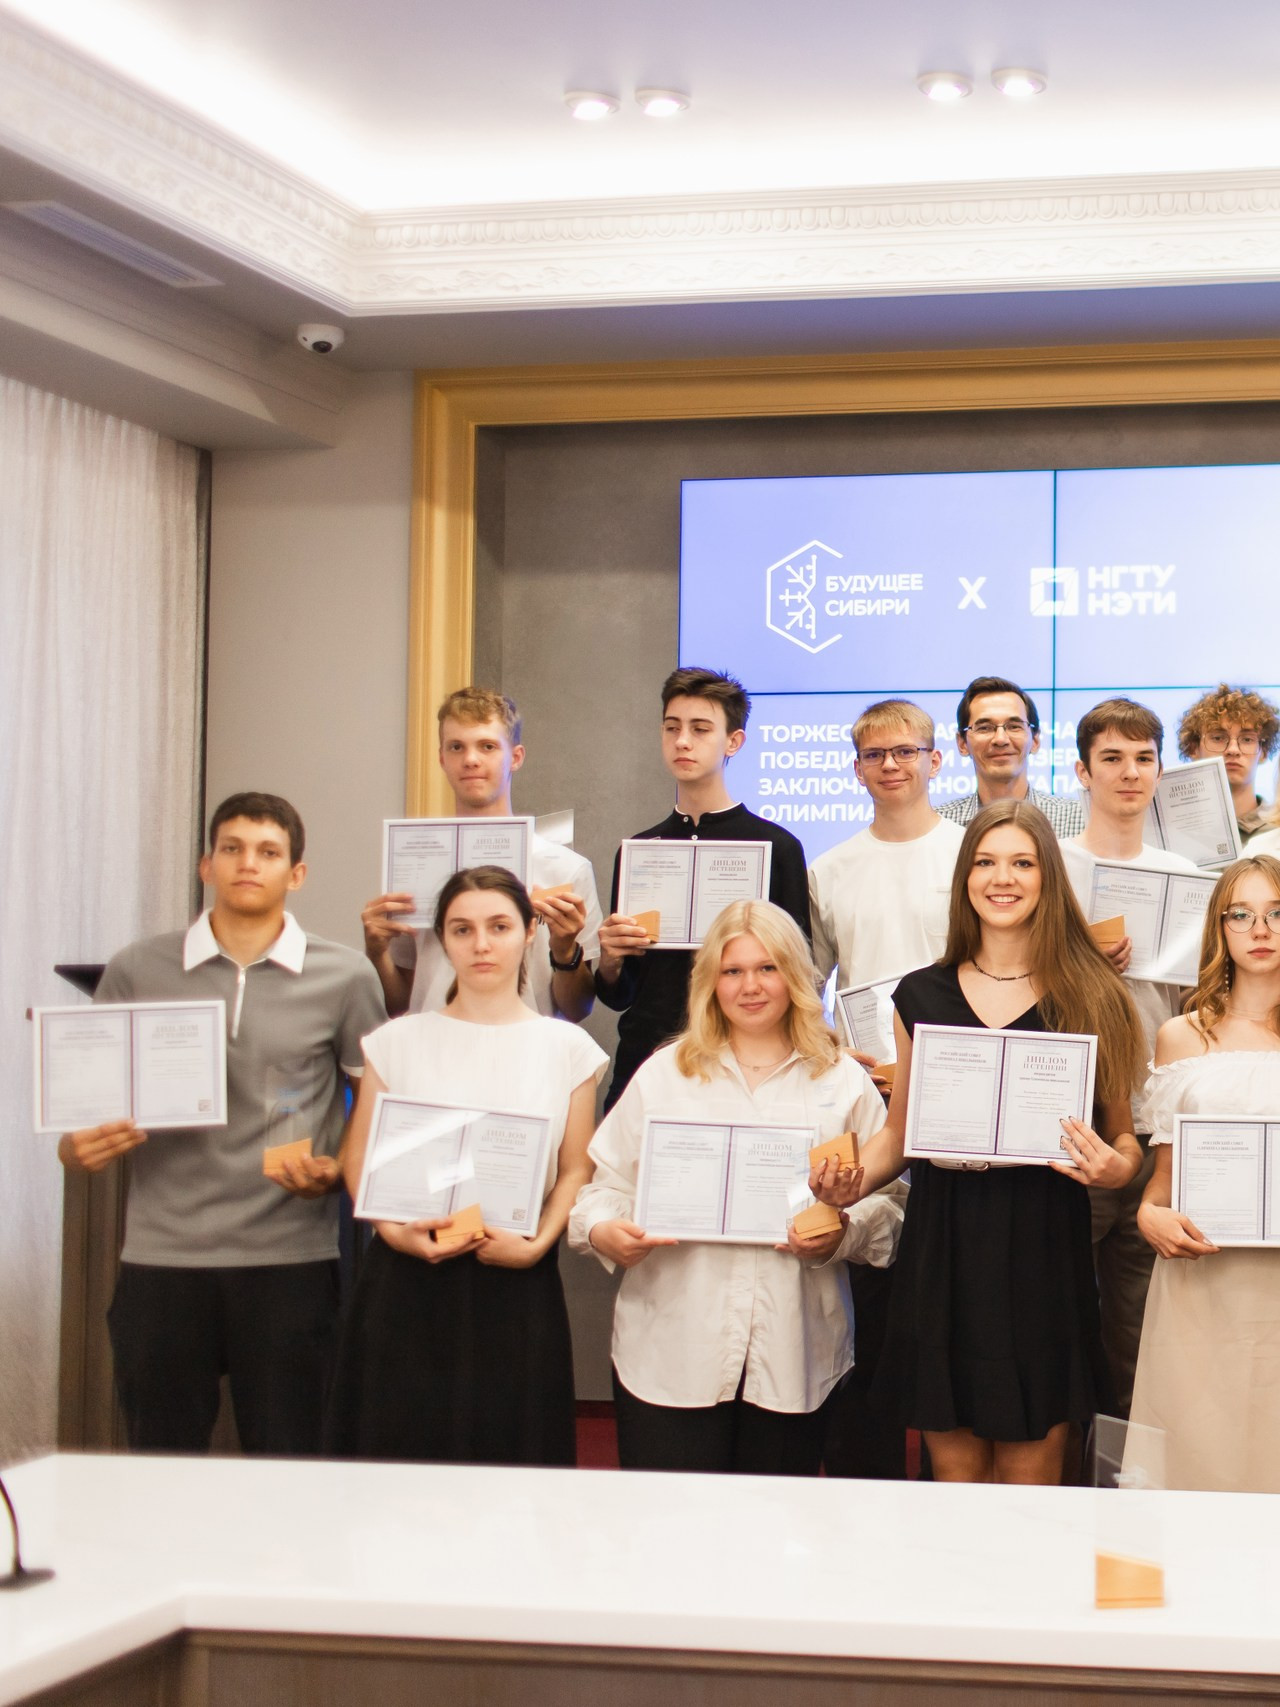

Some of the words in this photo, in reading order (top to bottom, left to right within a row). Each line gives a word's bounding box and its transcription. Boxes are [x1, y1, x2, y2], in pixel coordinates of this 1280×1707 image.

[825, 573, 924, 593] БУДУЩЕЕ
[1087, 564, 1178, 590] НГТУ
[825, 598, 910, 616] СИБИРИ
[1087, 591, 1178, 616] НЭТИ
[759, 723, 958, 743] ТОРЖЕСАЯ
[759, 803, 874, 822] ОЛИМПИА
